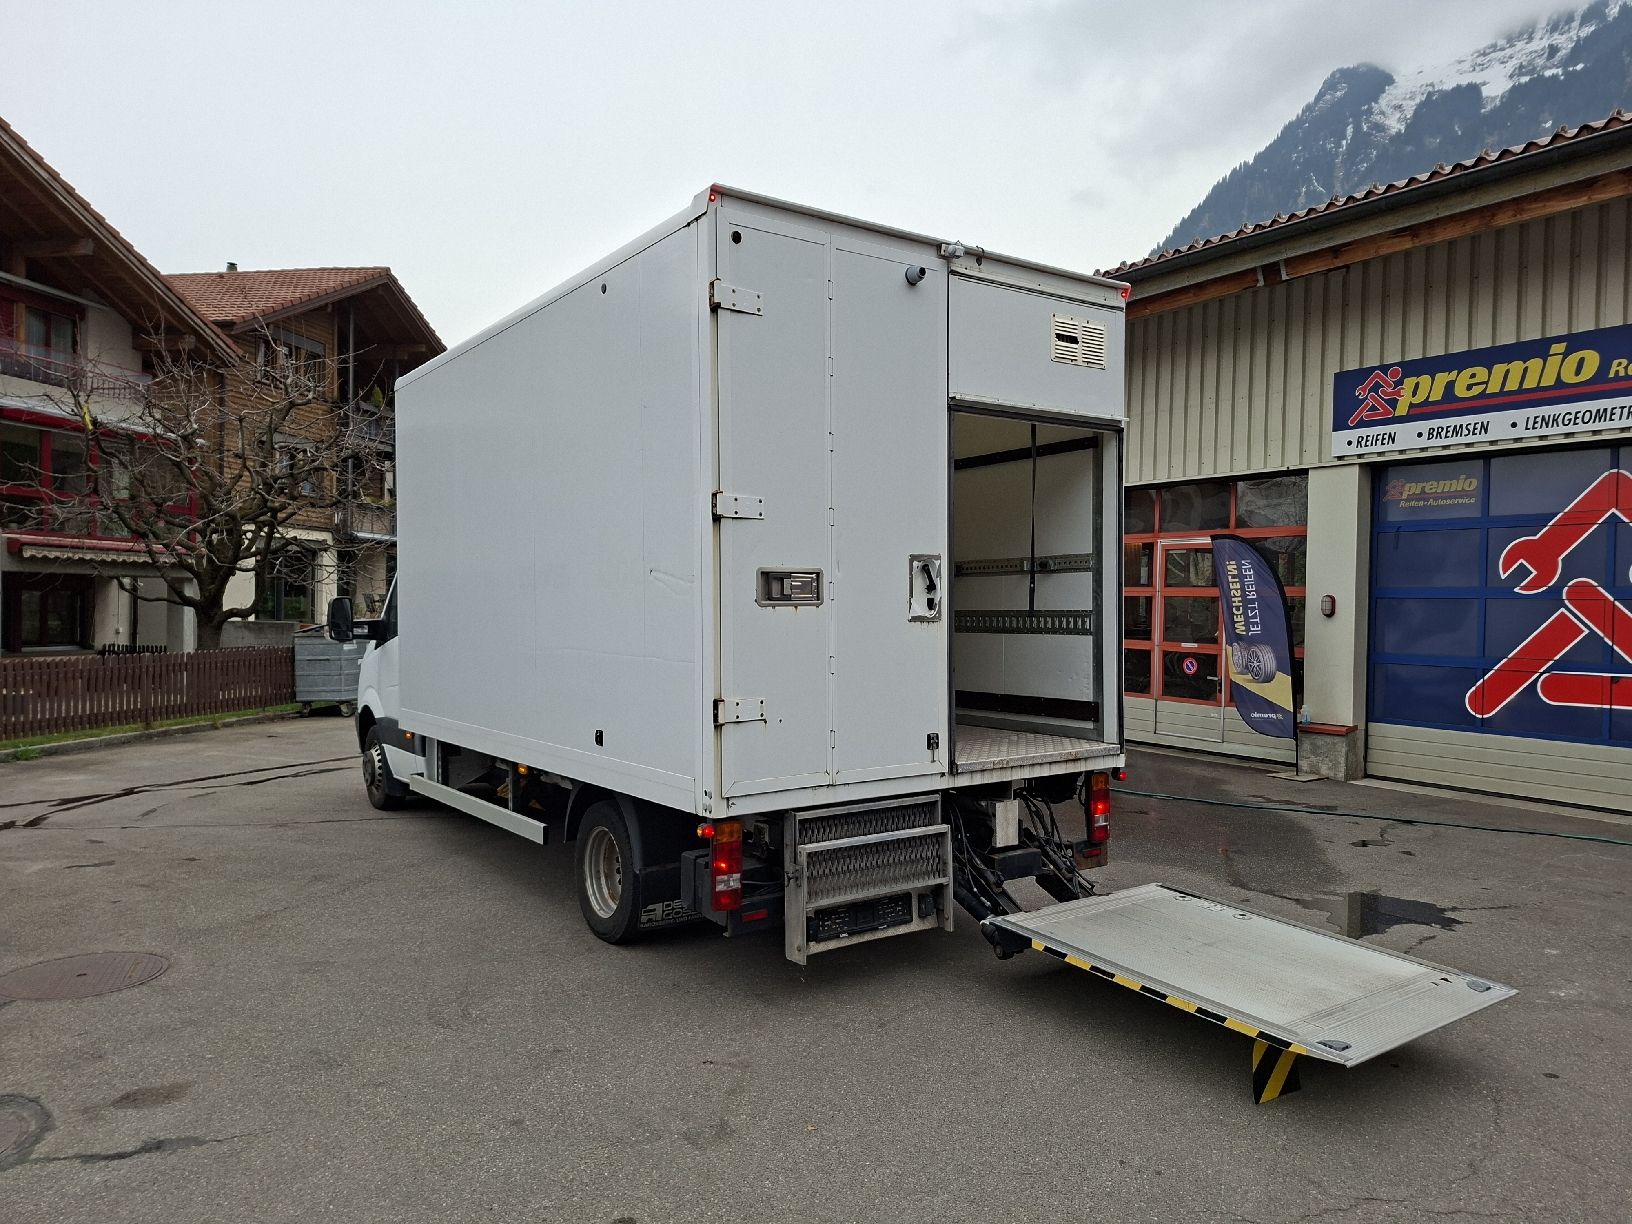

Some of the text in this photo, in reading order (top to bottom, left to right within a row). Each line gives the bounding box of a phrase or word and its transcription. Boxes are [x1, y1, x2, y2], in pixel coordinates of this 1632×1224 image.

[1395, 342, 1600, 416] premio
[1356, 431, 1397, 449] REIFEN
[1427, 421, 1491, 441] BREMSEN
[1402, 475, 1478, 499] premio
